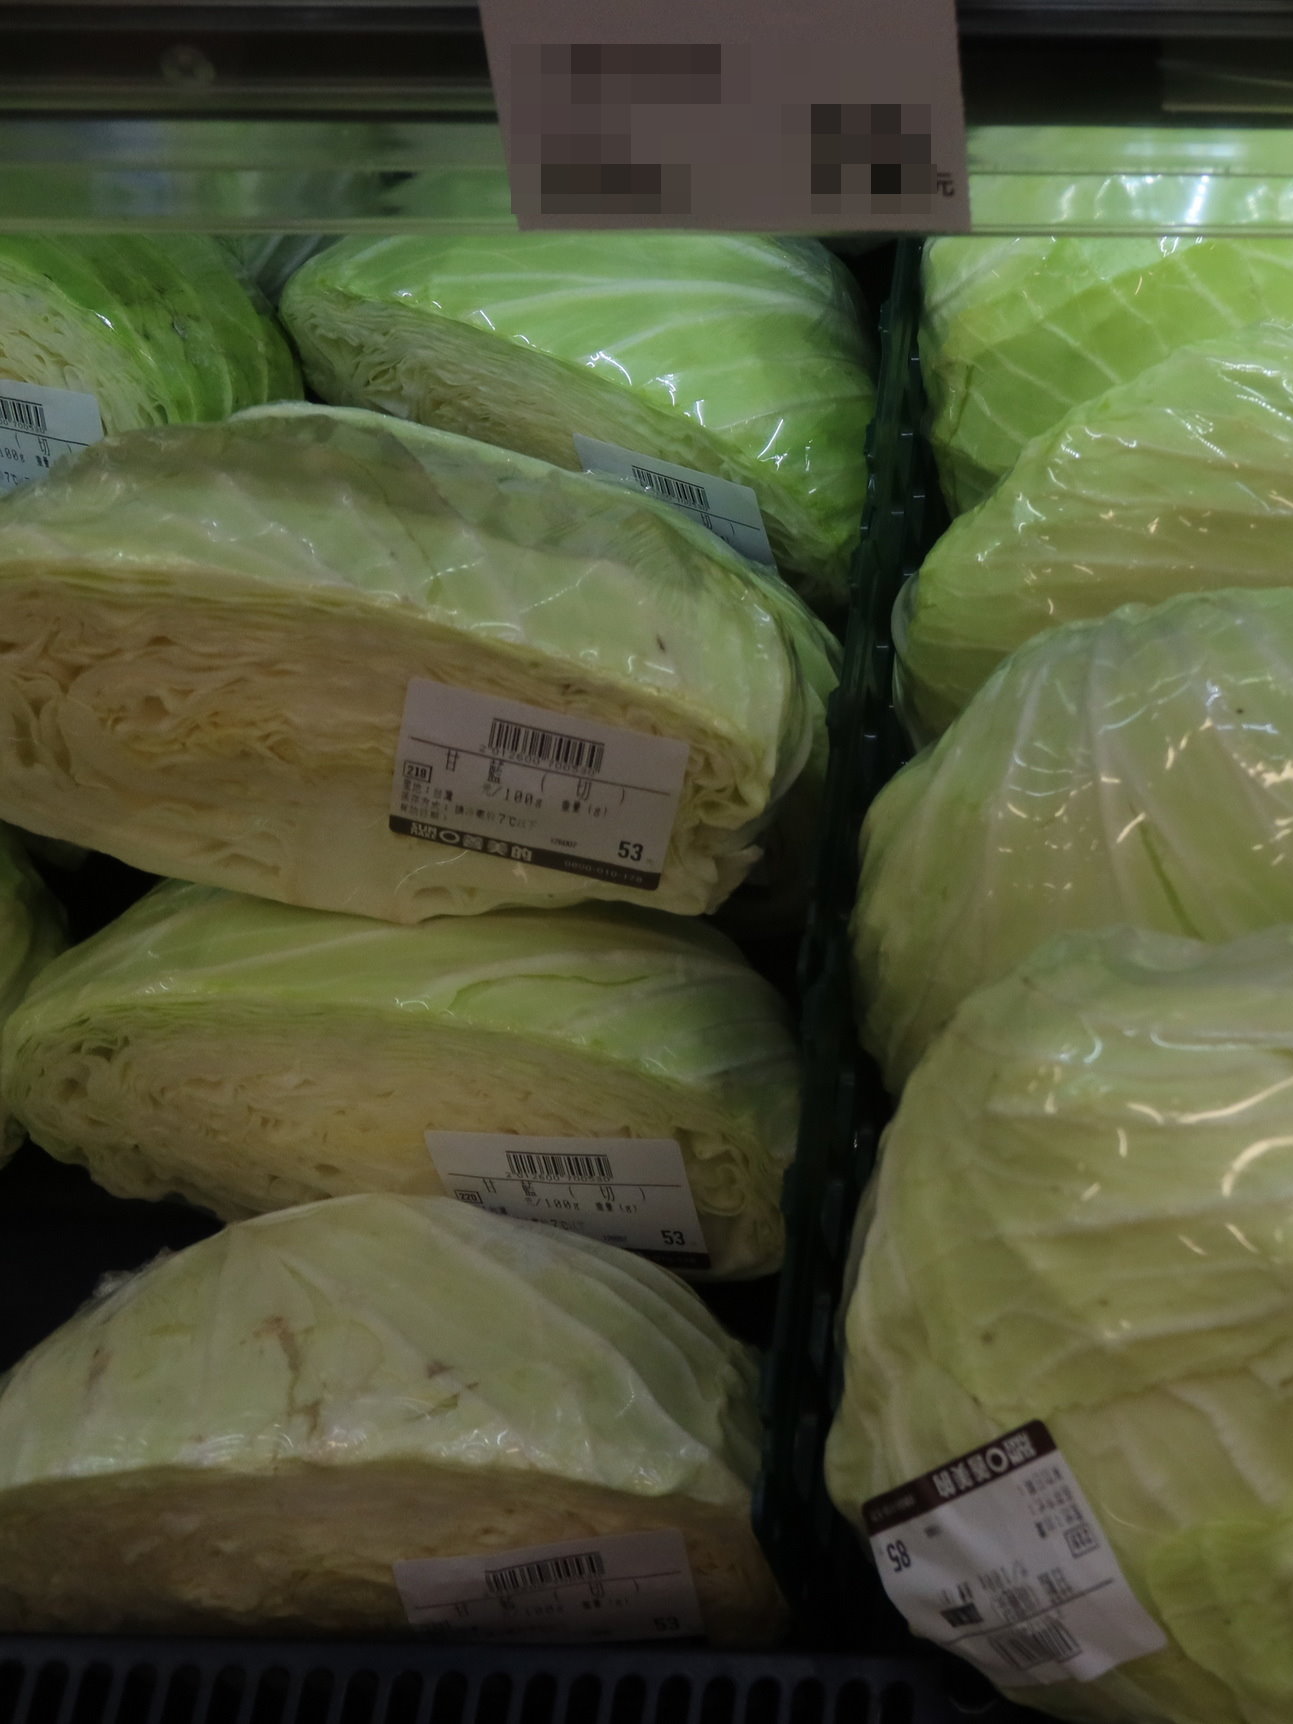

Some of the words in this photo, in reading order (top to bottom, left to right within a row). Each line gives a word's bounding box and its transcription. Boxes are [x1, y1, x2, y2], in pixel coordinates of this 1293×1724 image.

[616, 840, 644, 862] 53
[660, 1229, 686, 1247] 53
[653, 1615, 681, 1633] 53
